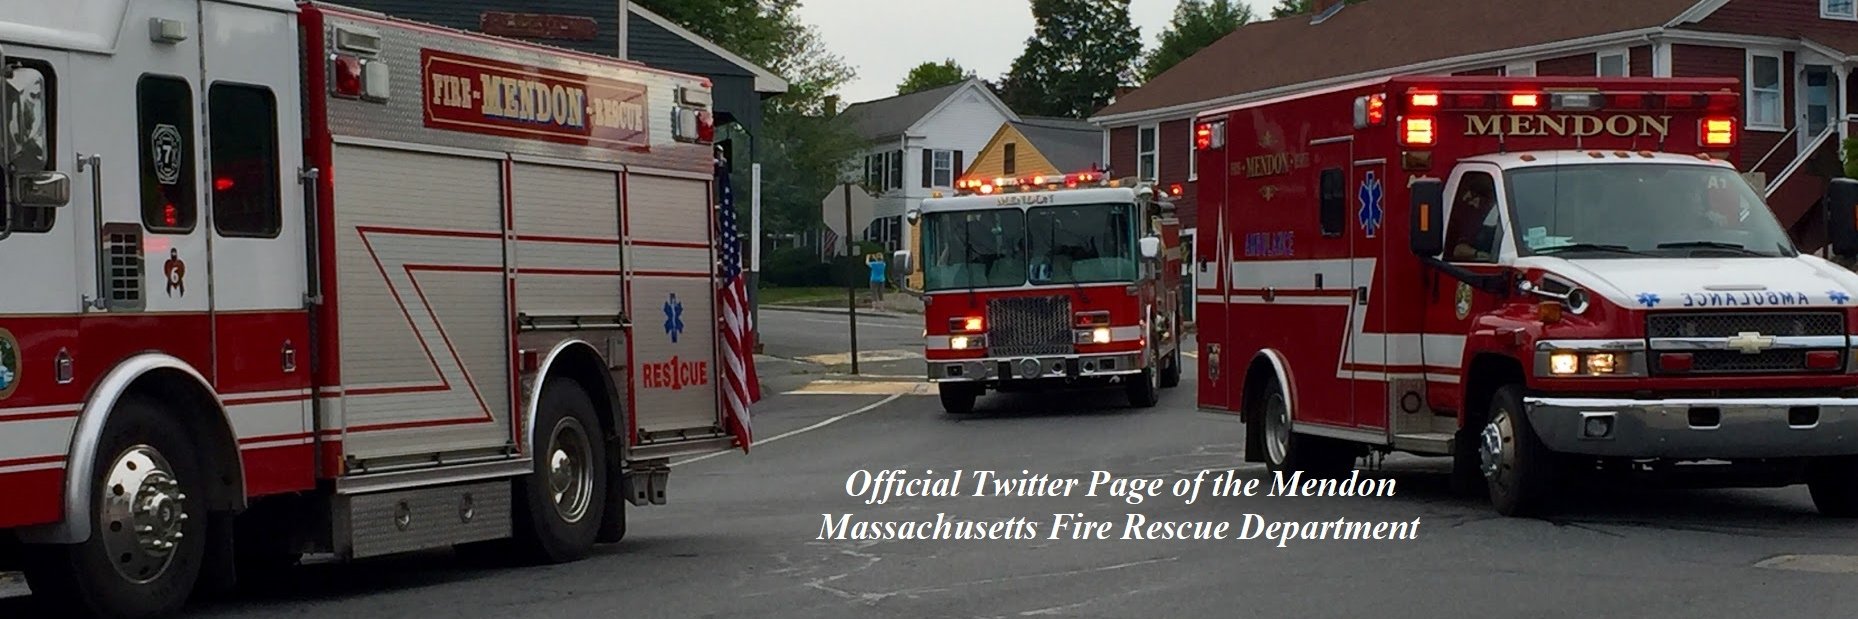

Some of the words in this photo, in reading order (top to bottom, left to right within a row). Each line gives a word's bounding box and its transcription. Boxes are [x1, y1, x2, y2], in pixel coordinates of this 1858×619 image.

[432, 73, 472, 109] FIRE
[480, 74, 584, 128] MENDON
[594, 98, 643, 132] RESCUE
[1463, 113, 1673, 137] MENDON
[162, 144, 172, 164] 7
[1246, 152, 1288, 178] MENDON
[171, 266, 179, 283] 6
